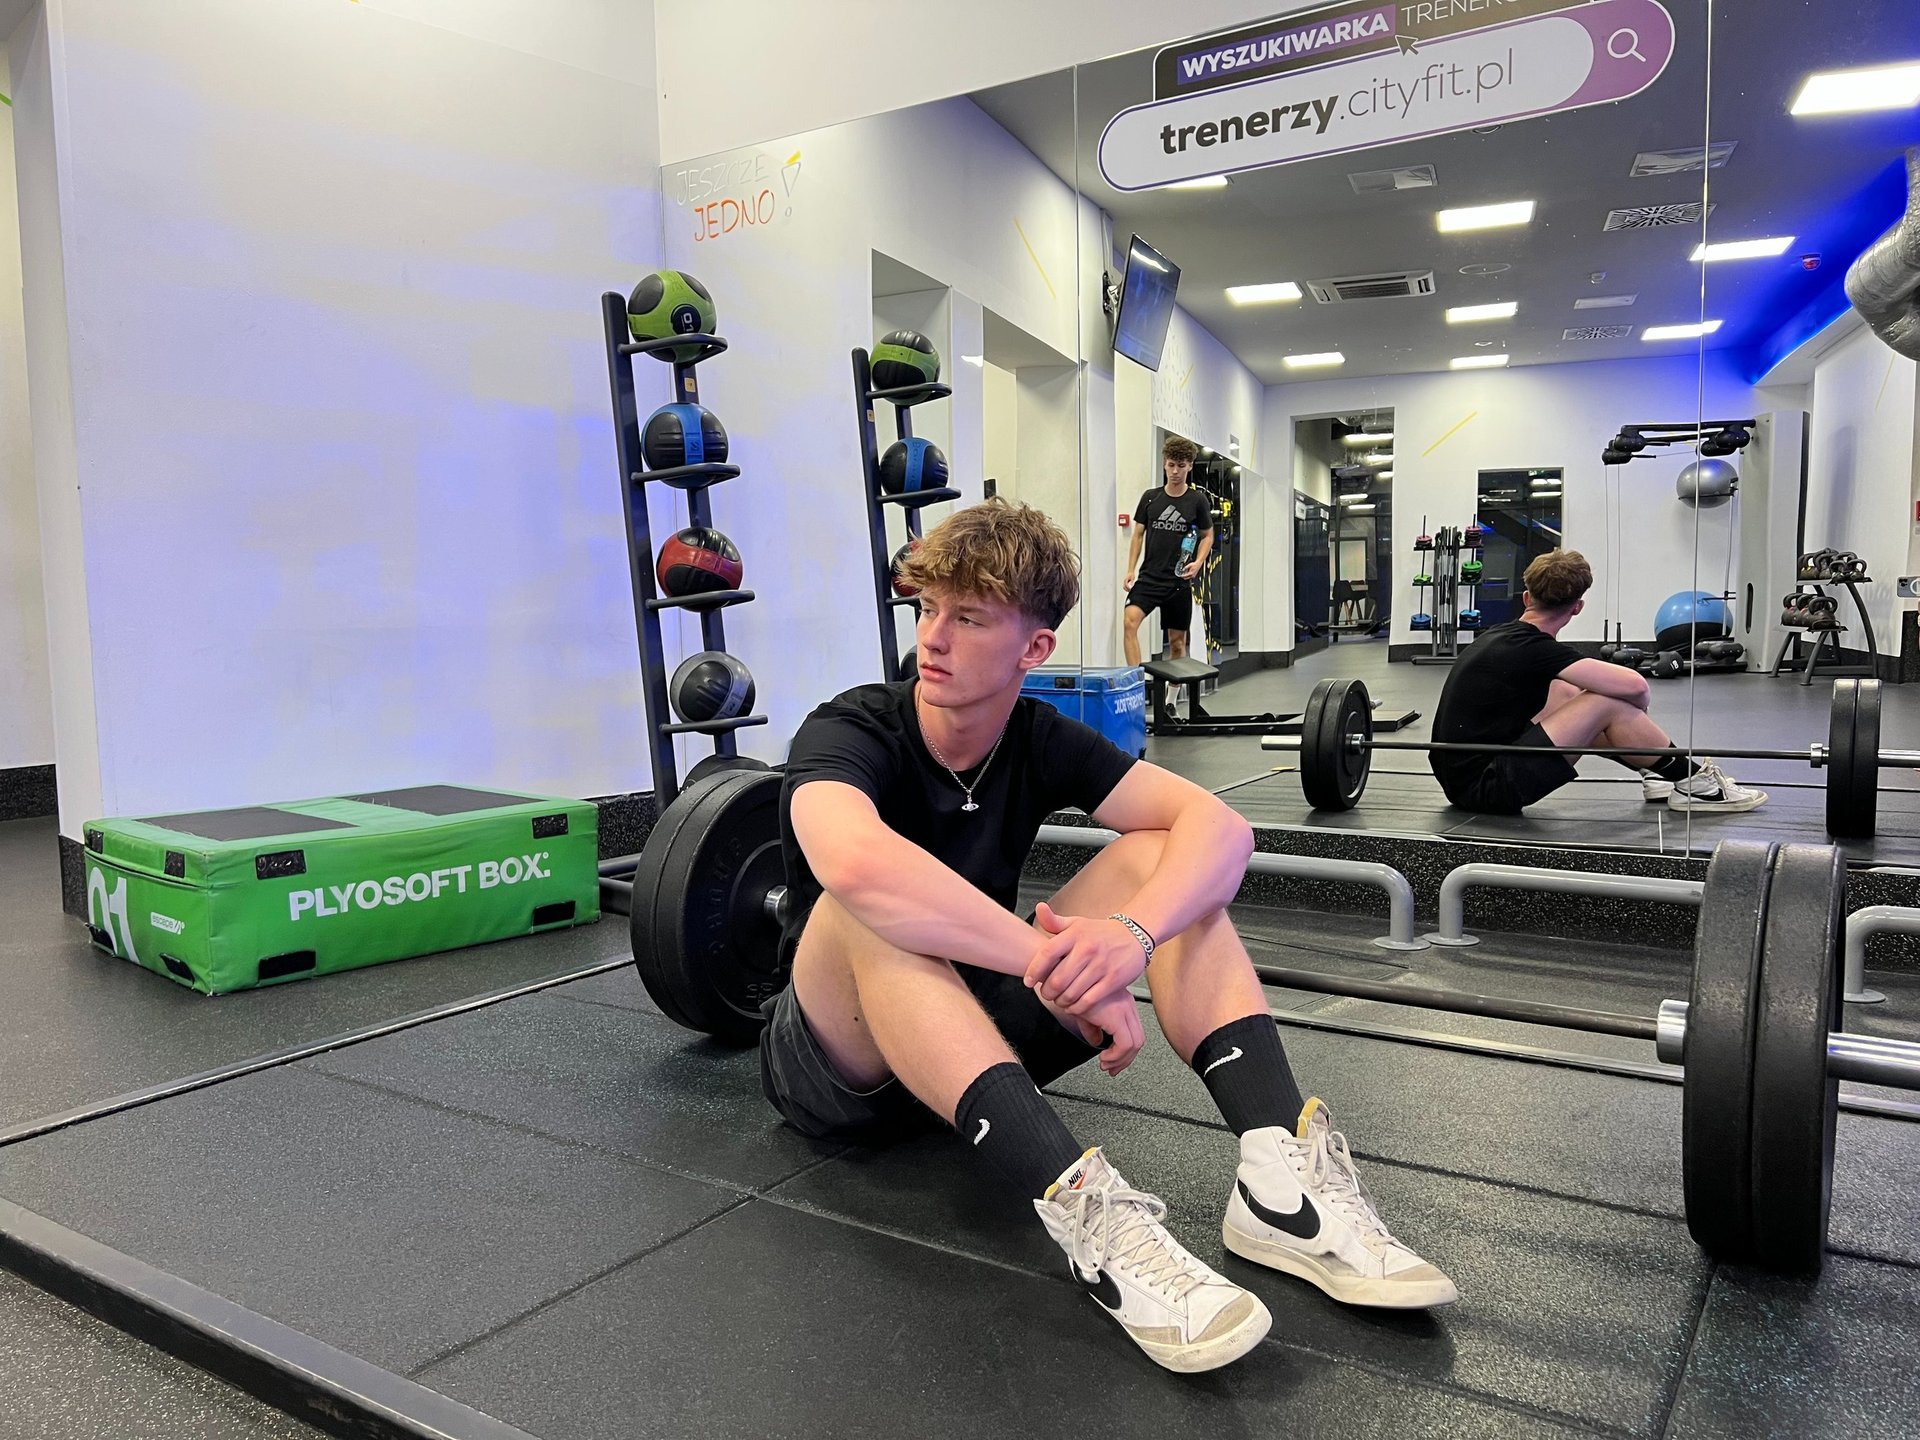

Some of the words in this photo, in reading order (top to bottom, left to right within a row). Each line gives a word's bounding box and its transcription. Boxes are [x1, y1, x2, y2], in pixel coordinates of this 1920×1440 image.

[1182, 13, 1390, 78] WYSZUKIWARKA
[1401, 0, 1518, 27] TRENE
[1160, 48, 1512, 155] trenerzy.cityfit.pl
[288, 864, 472, 921] PLYOSOFT
